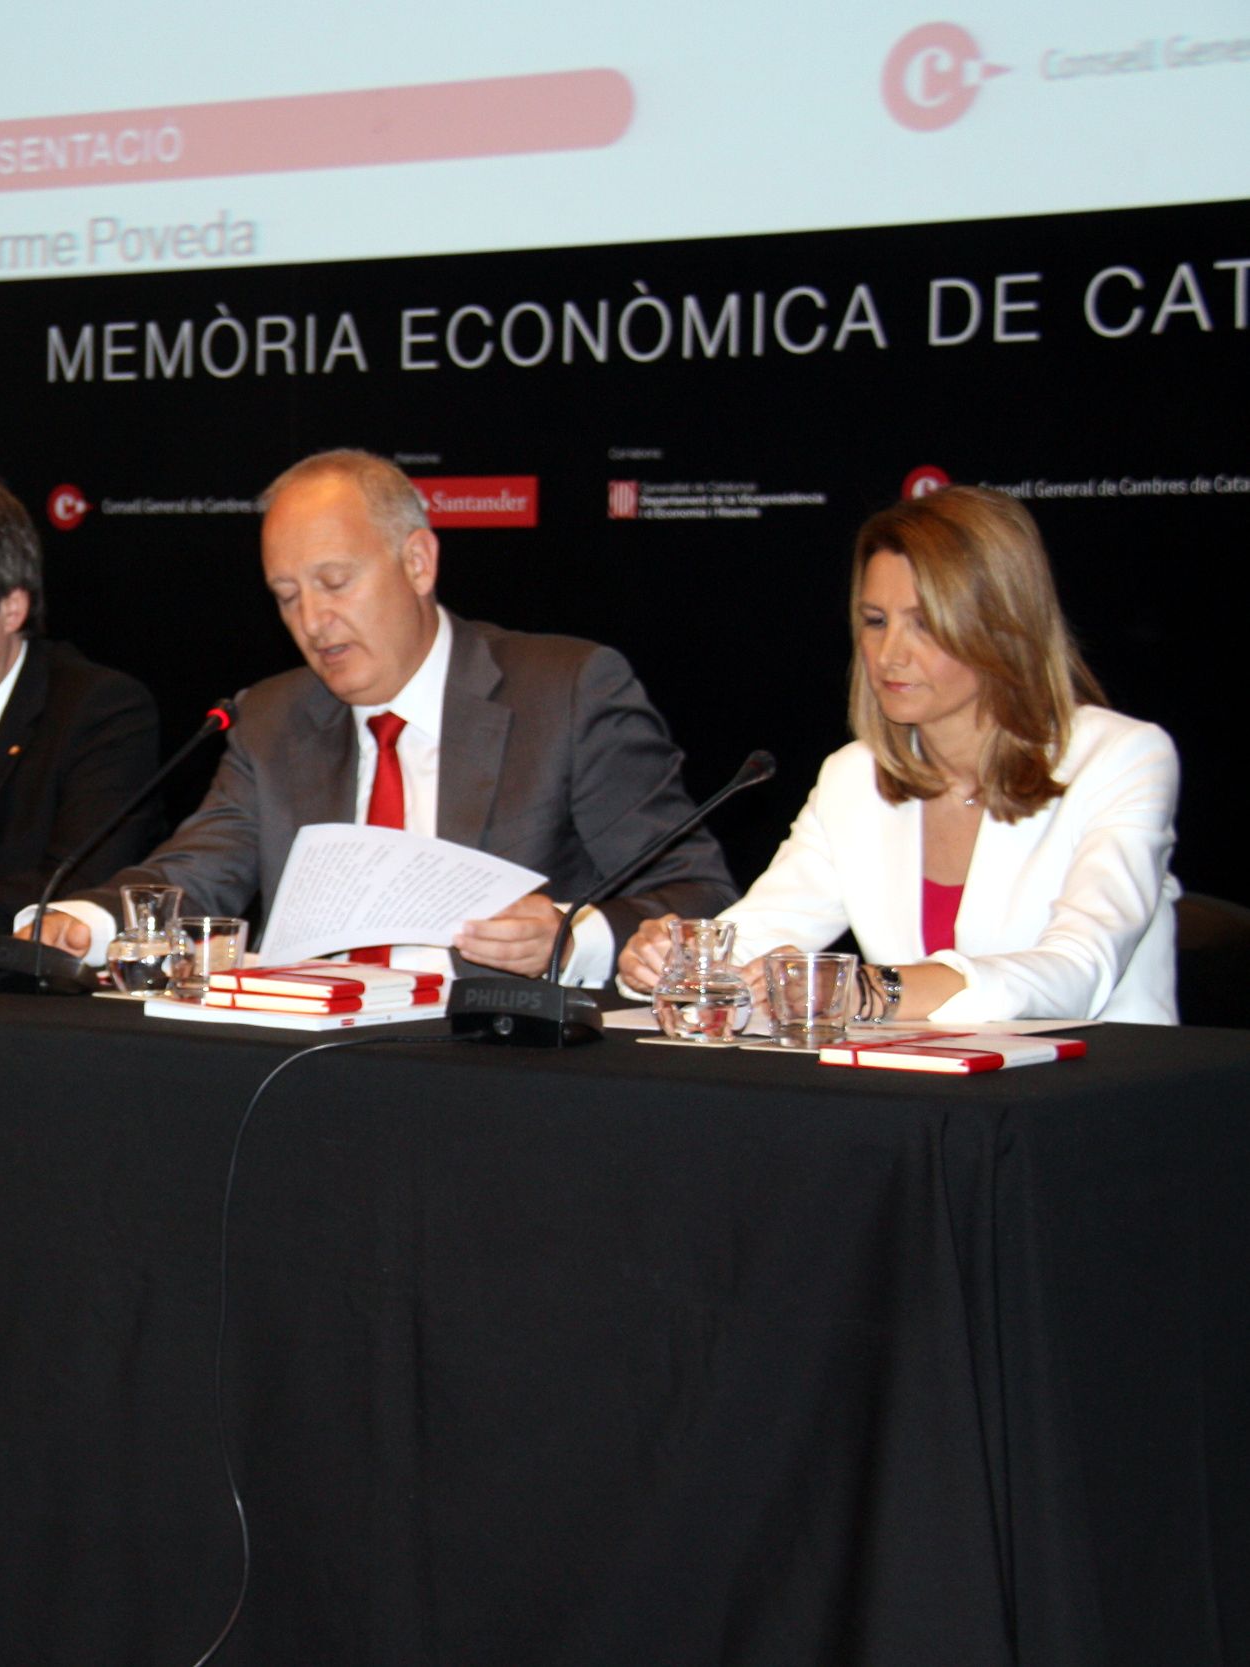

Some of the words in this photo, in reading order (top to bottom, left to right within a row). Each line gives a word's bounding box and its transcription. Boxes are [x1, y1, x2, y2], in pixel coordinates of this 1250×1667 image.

[88, 209, 258, 267] Poveda
[47, 304, 369, 384] MEMÒRIA
[399, 281, 888, 371] ECONÒMICA
[928, 272, 1043, 347] DE
[1034, 478, 1095, 498] General
[1097, 478, 1117, 497] de
[1119, 476, 1188, 495] Cambres
[1190, 475, 1210, 494] de
[430, 488, 528, 514] Santander
[463, 988, 543, 1010] PHILIPS
